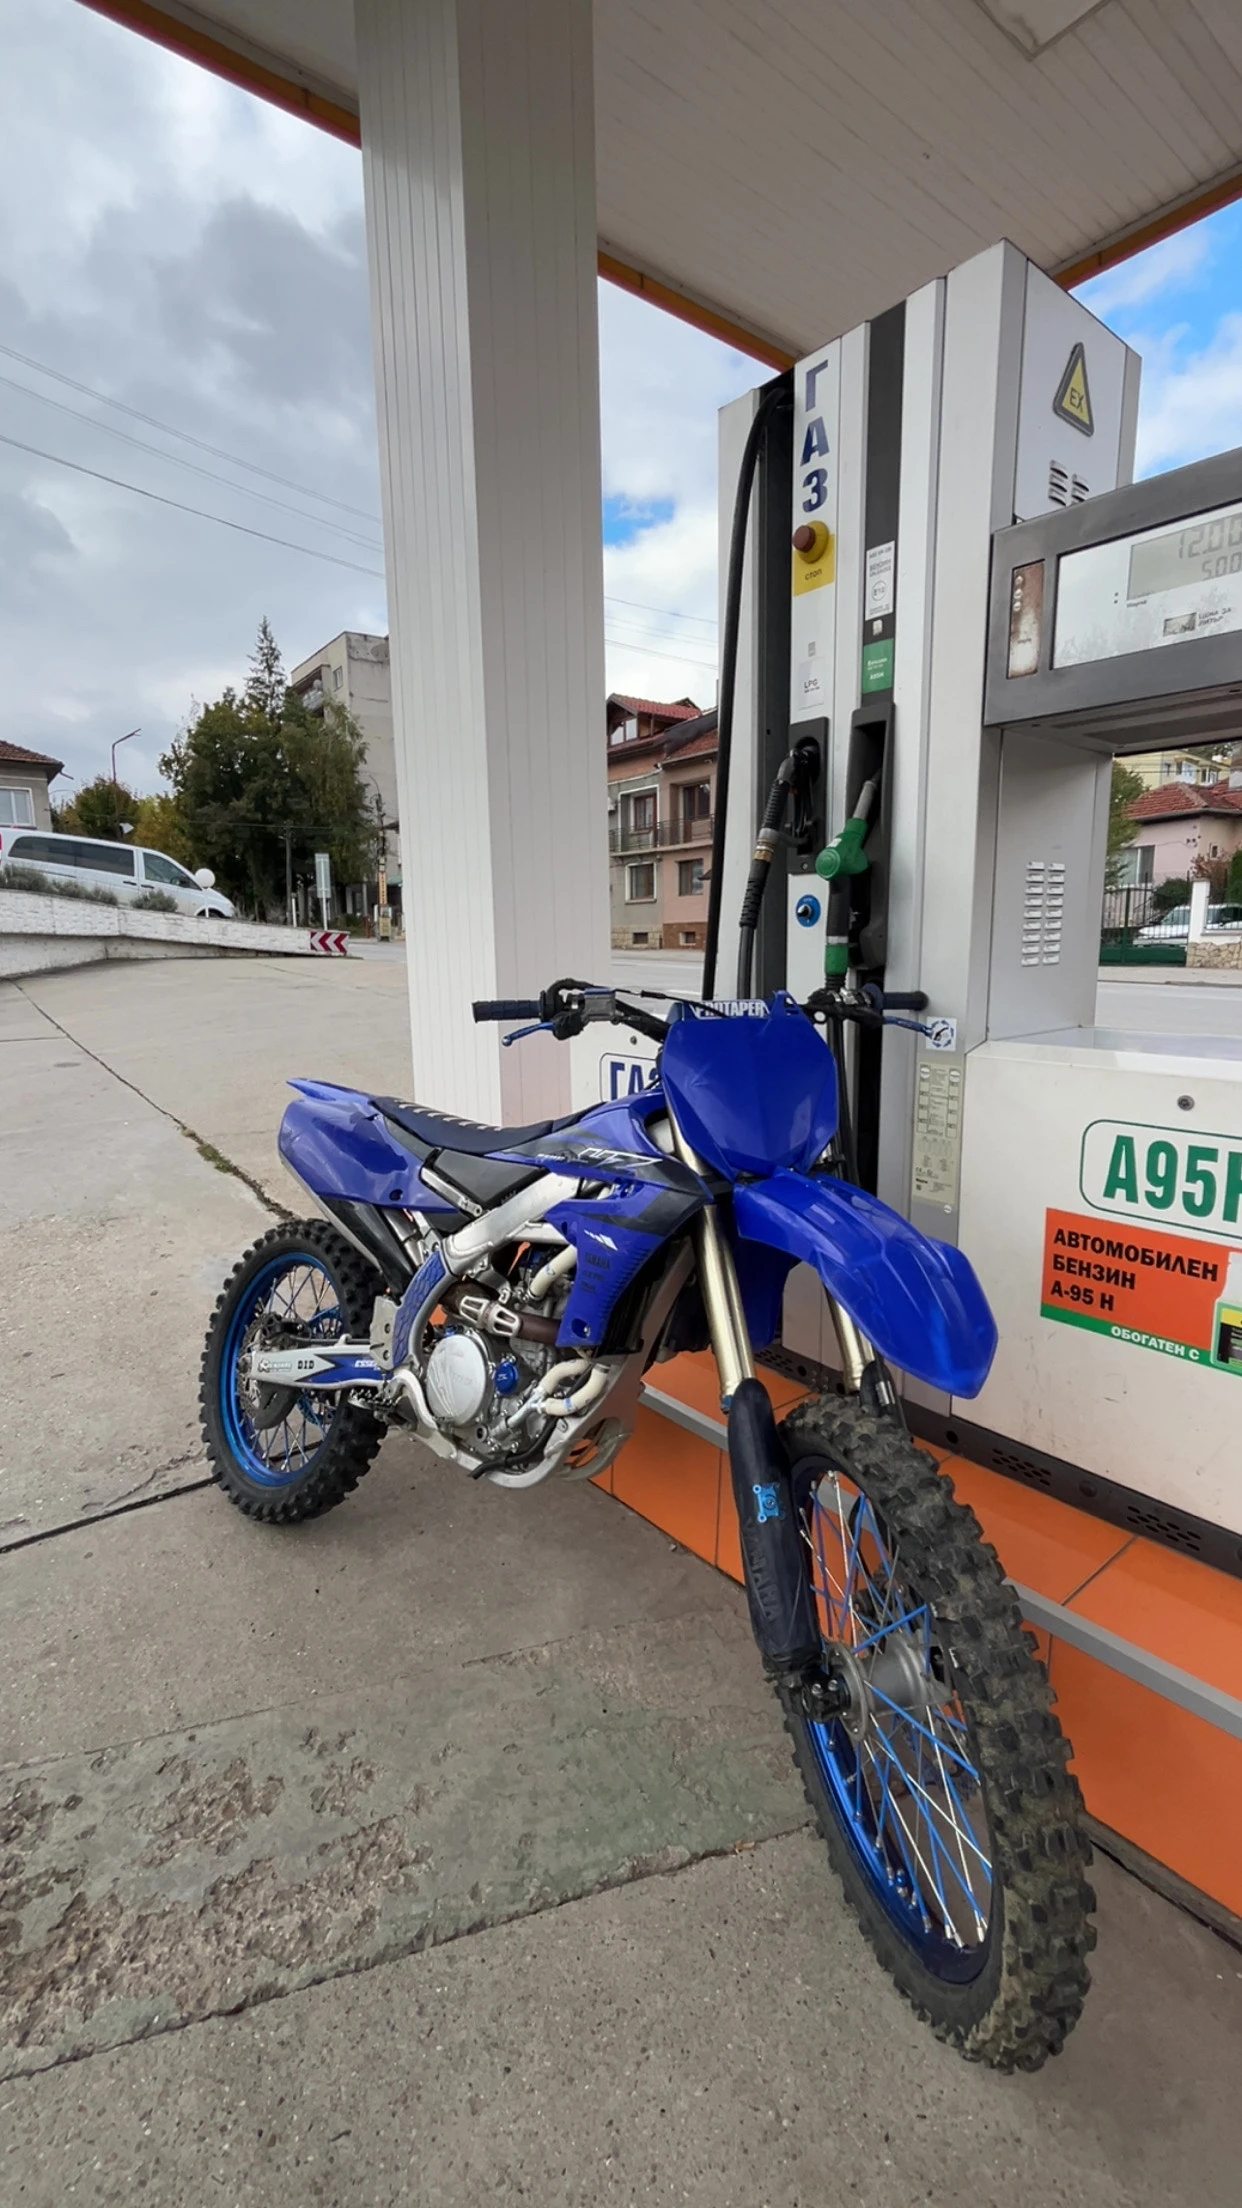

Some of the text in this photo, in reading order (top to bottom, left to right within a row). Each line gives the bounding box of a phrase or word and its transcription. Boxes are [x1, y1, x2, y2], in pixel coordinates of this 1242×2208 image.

[1070, 387, 1084, 413] EX
[801, 359, 830, 513] ГАЗ
[804, 679, 819, 689] LPG
[611, 1061, 659, 1101] ГА
[1053, 1254, 1136, 1290] БЕНЗИН
[1054, 1228, 1219, 1282] АВТОМОБИЛЕН
[1050, 1280, 1114, 1311] А-95 Н
[1110, 1326, 1200, 1360] ОБОГАТЕН С
